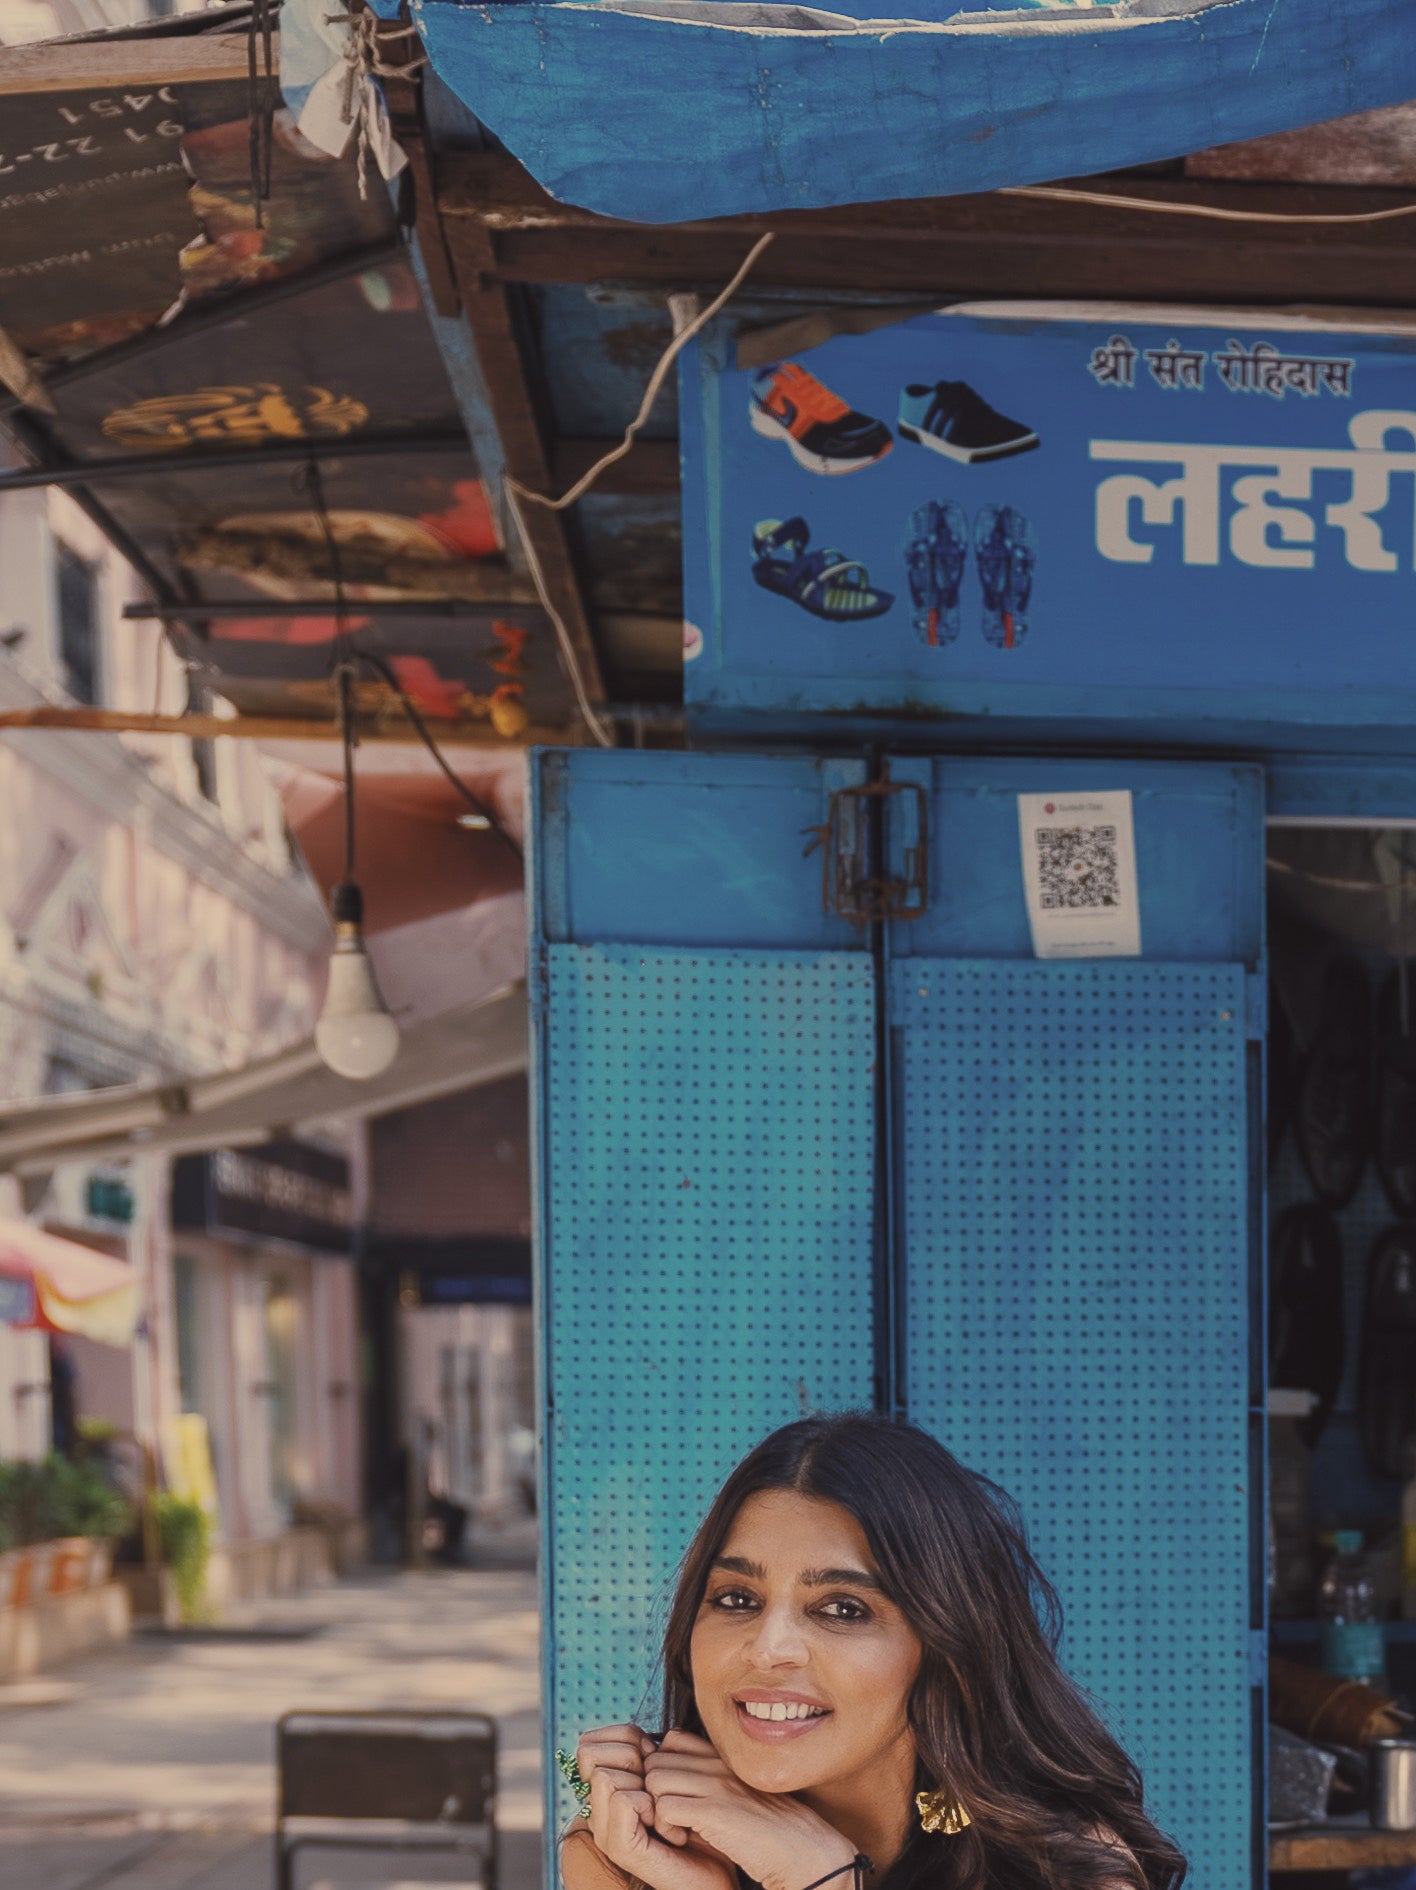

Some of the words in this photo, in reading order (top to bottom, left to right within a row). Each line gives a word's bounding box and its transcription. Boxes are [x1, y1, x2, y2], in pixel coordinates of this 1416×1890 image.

[1091, 338, 1136, 386] श्री
[1147, 342, 1204, 387] संत
[1215, 342, 1353, 396] रोहिदास
